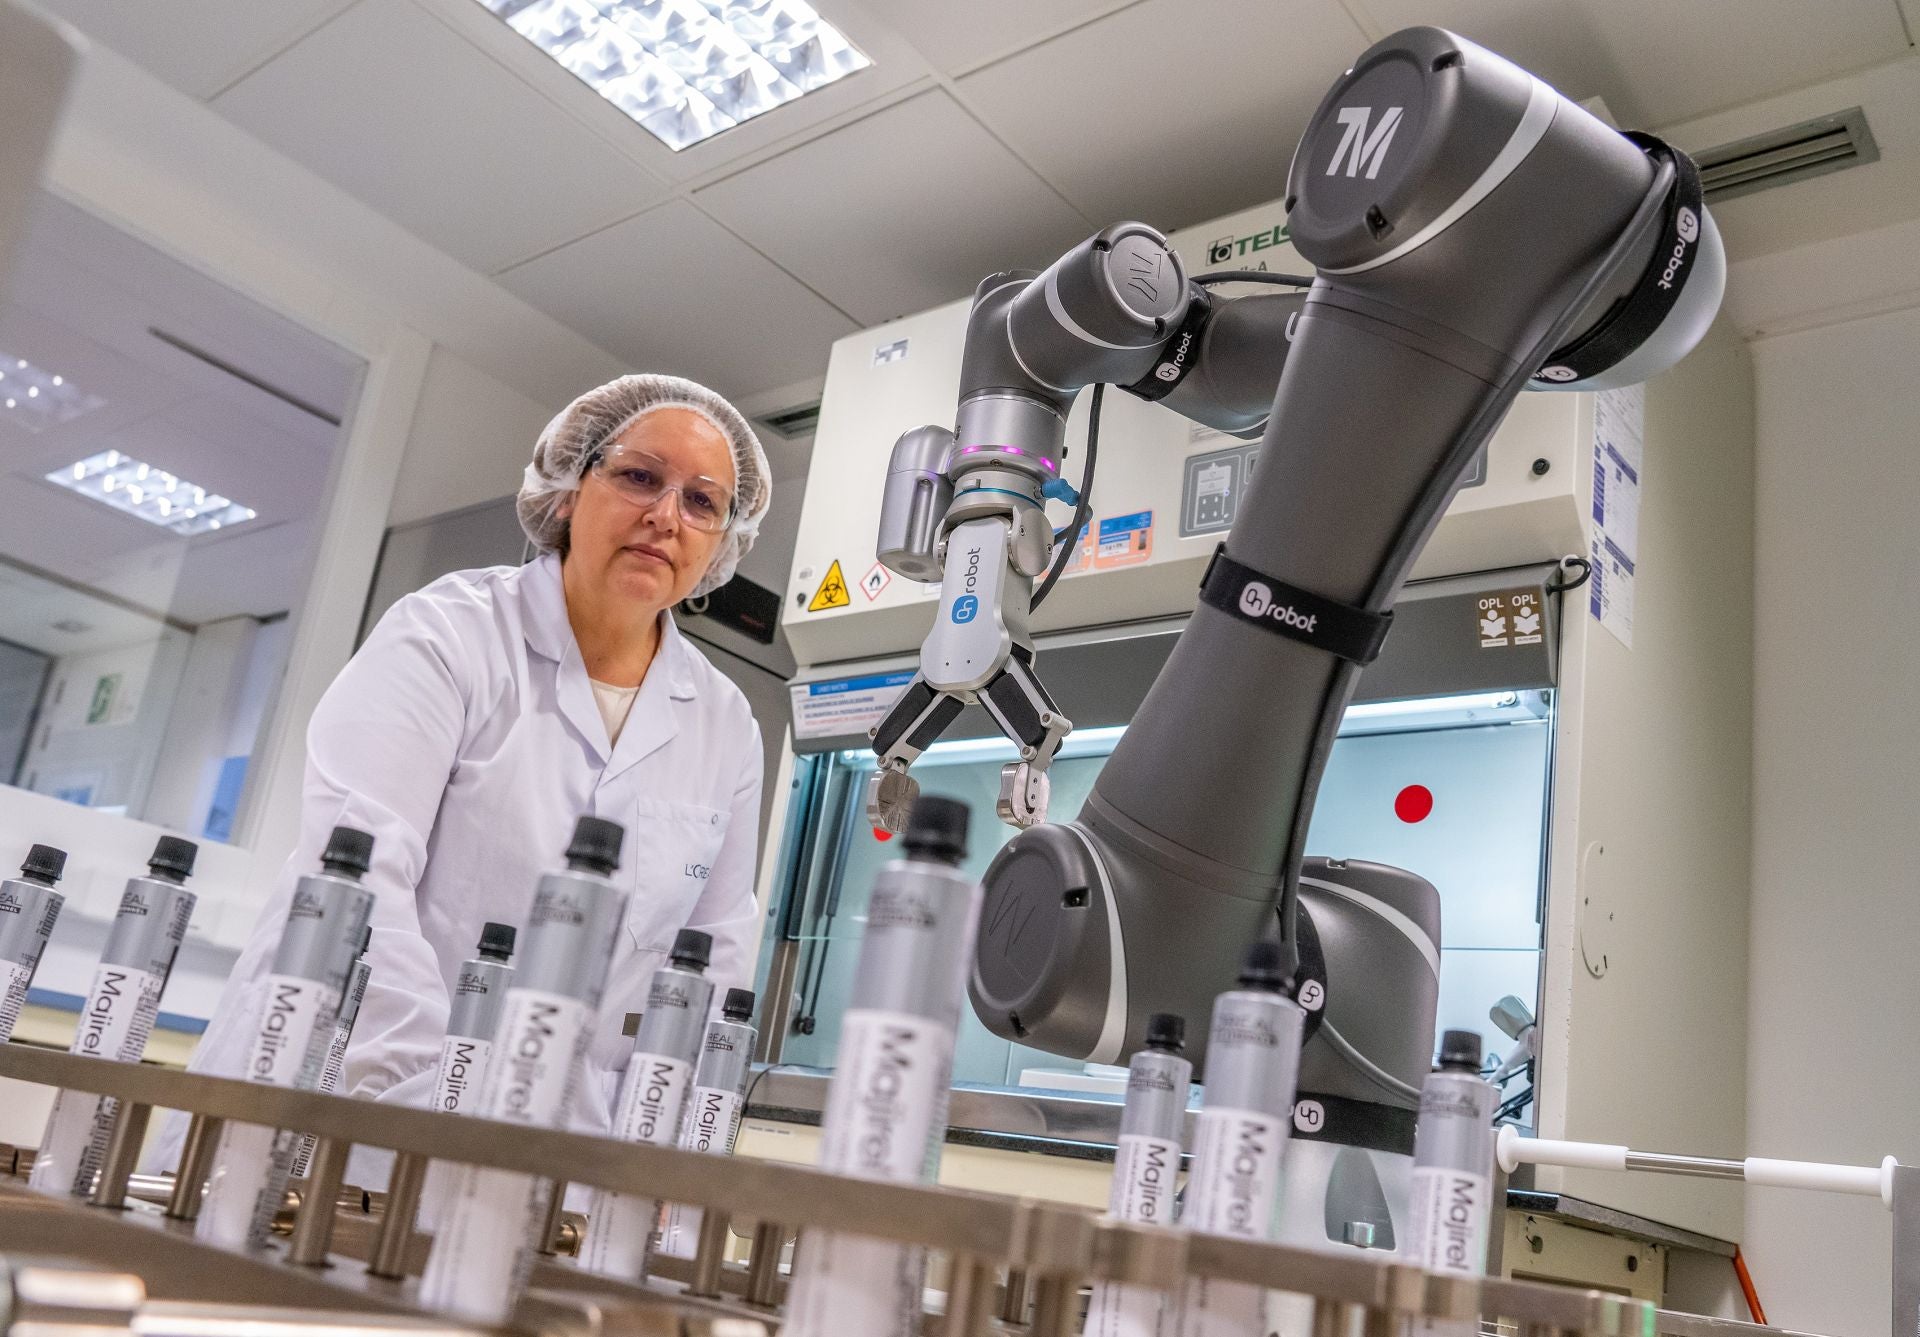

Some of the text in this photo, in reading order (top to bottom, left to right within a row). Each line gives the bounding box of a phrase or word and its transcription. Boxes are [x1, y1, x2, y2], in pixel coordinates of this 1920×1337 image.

[1478, 597, 1504, 610] OPL
[1511, 594, 1538, 607] OPL
[82, 972, 127, 1055] Majirel
[254, 984, 302, 1081] Majirel
[636, 1062, 675, 1145] Majirel
[697, 1093, 724, 1153] Majire
[1137, 1144, 1168, 1225] Majirel
[1443, 1178, 1476, 1270] Majirel
